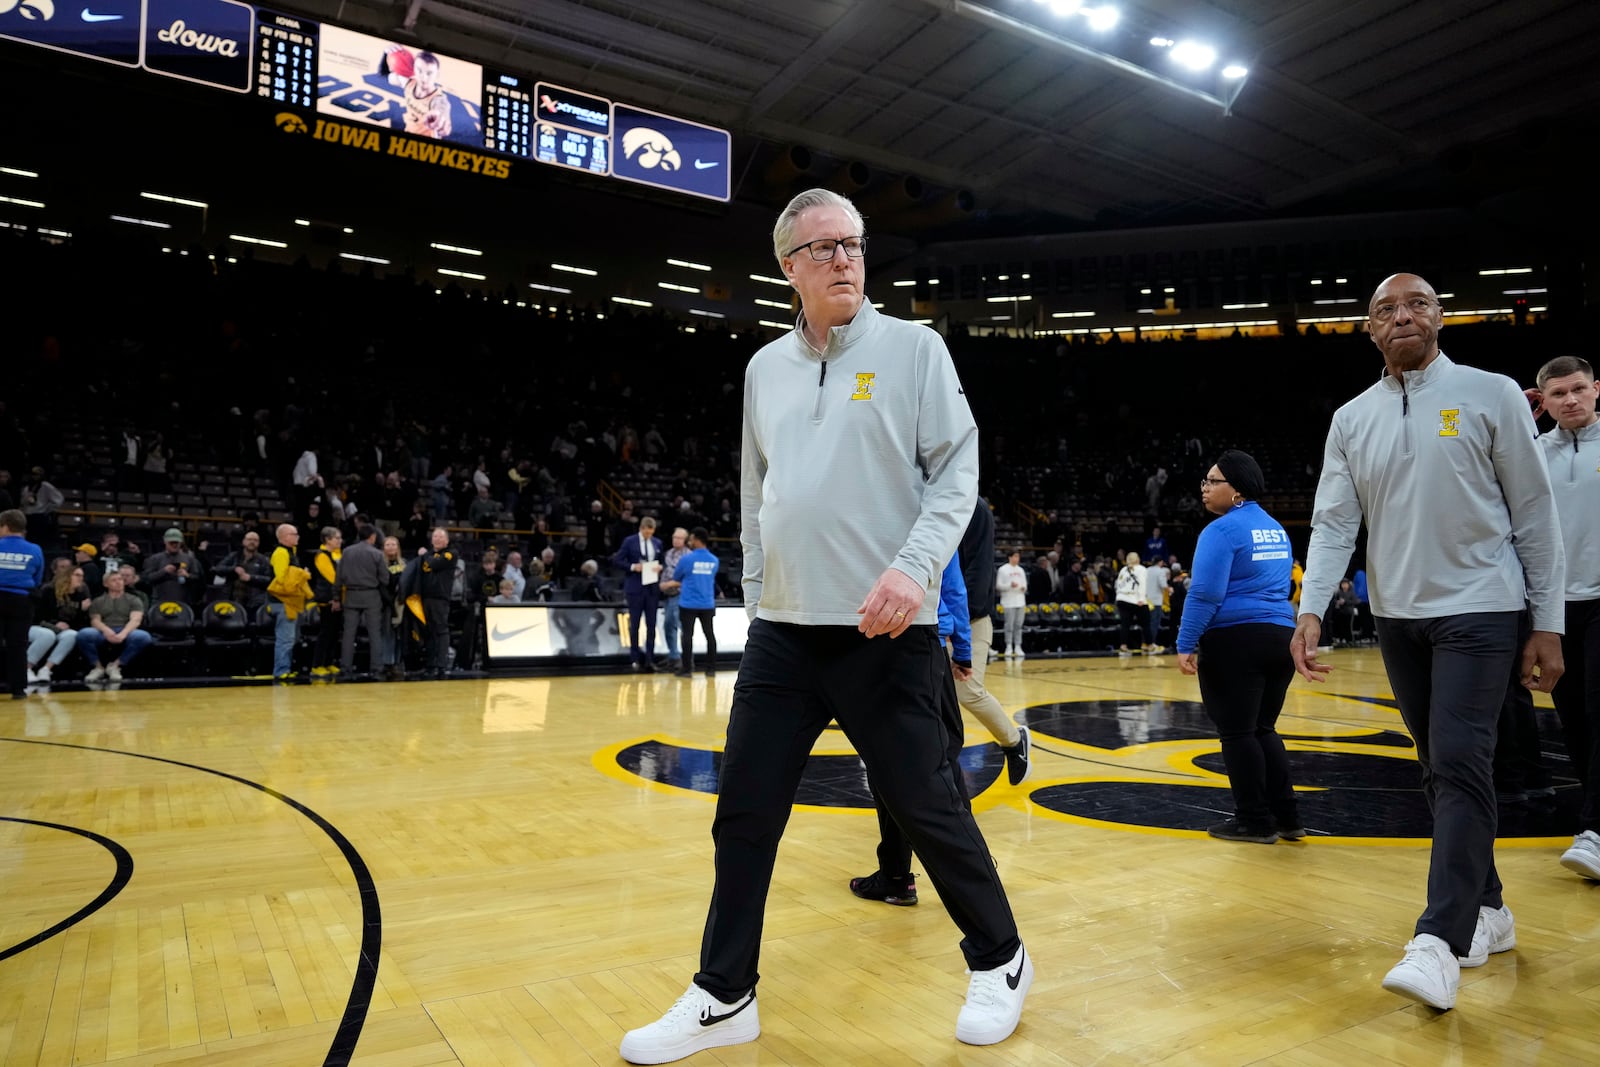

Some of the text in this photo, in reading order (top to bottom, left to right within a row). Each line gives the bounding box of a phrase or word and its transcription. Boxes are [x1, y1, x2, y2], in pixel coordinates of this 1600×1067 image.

[275, 16, 300, 29] IOWA
[157, 19, 239, 58] Iowa
[304, 60, 311, 71] 1
[292, 69, 298, 80] 1
[312, 119, 511, 179] IOWA HAWKEYES
[1251, 529, 1288, 543] BEST
